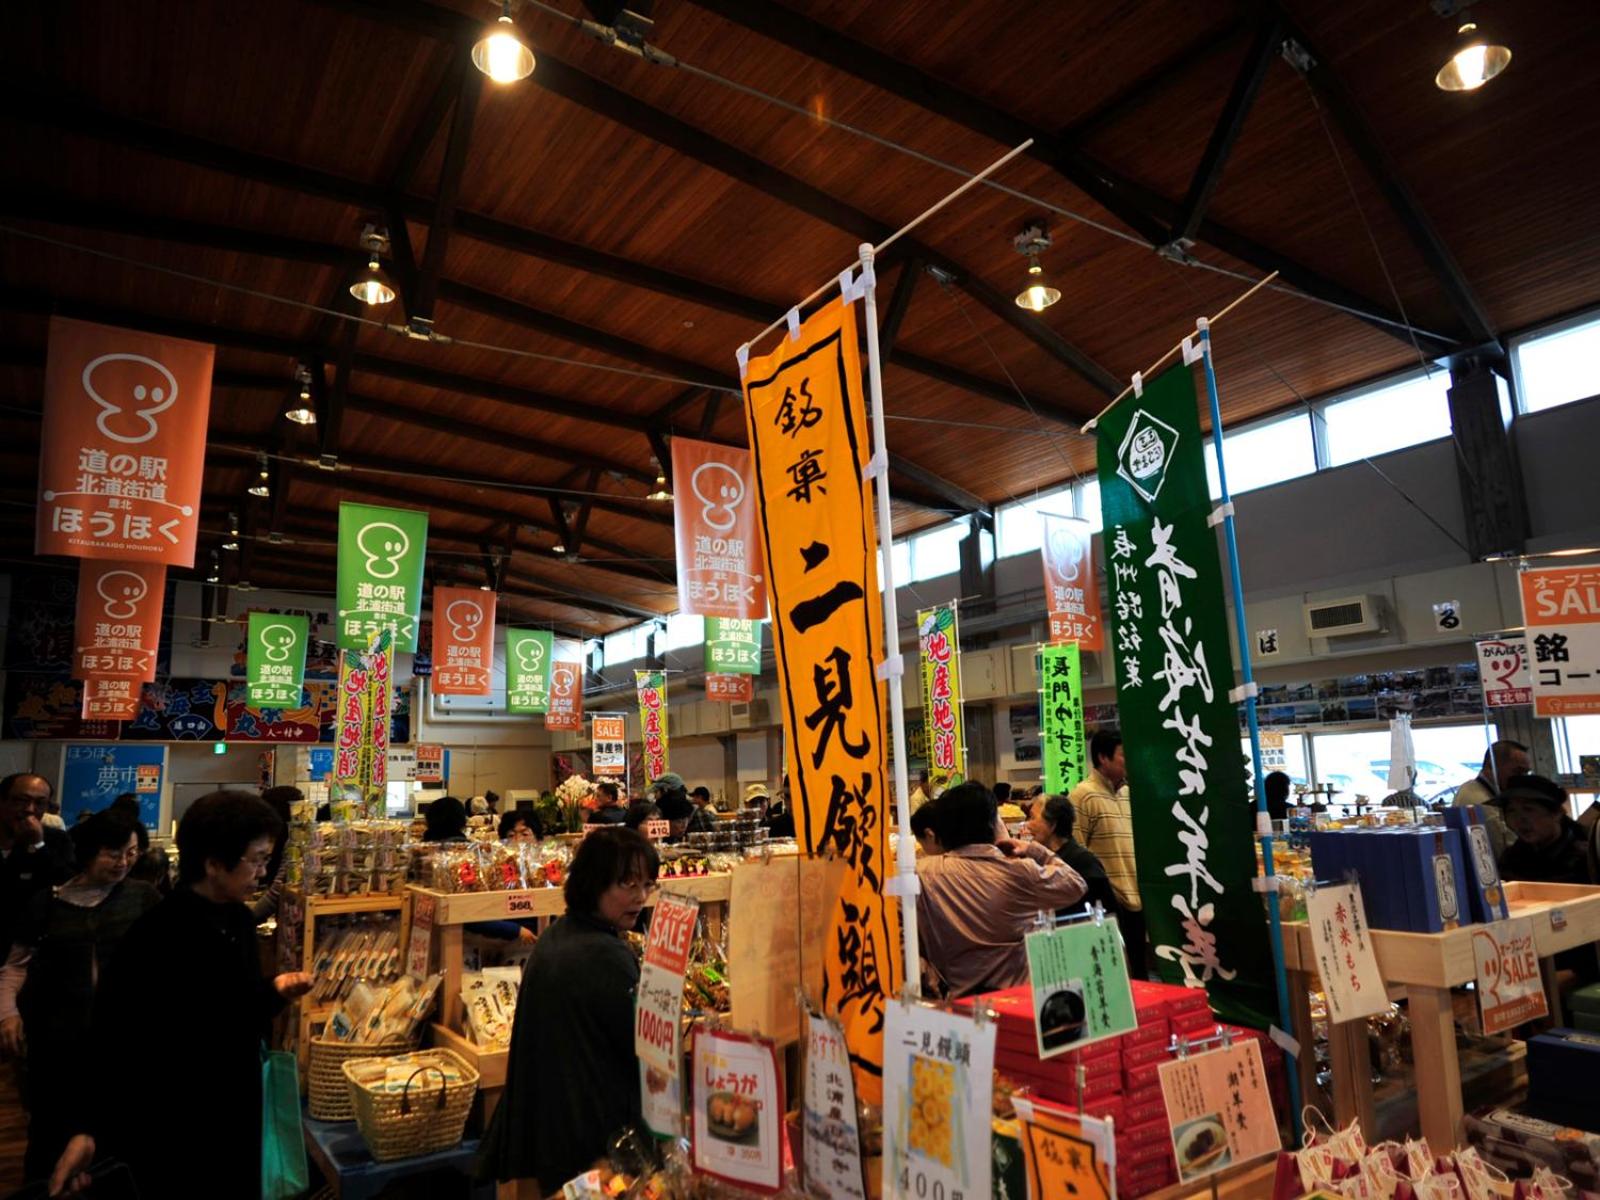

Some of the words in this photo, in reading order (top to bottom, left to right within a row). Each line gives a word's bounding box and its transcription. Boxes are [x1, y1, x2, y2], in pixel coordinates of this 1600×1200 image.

[78, 448, 168, 480] 道の駅
[76, 474, 167, 502] 北浦街道
[52, 506, 180, 545] ほうほく
[696, 535, 744, 557] 道の駅
[1534, 573, 1600, 590] オープニ
[357, 582, 405, 600] 道の駅
[686, 581, 755, 604] ほうほく
[1054, 585, 1084, 602] 道の駅
[356, 599, 405, 614] 北浦街道
[719, 617, 753, 630] 道の駅
[1440, 608, 1460, 629] る
[95, 623, 143, 638] 道の駅
[1051, 620, 1094, 638] ほうほく
[447, 645, 481, 658] 道の駅
[711, 648, 759, 663] ほうほく
[1534, 633, 1569, 663] 銘
[81, 654, 149, 671] ほうほく
[259, 664, 293, 676] 道の駅
[98, 681, 130, 690] 道の駅
[439, 672, 488, 687] ほうほく
[517, 674, 543, 684] 道の駅
[1539, 668, 1600, 686] コー
[251, 688, 299, 700] ほうほく
[709, 682, 746, 694] ほうほく
[511, 695, 548, 706] ほうほく
[928, 630, 955, 769] 地産地消
[1490, 691, 1532, 705] 東北物
[89, 702, 135, 713] ほうほく
[372, 651, 388, 786] 地産地消
[546, 715, 576, 725] ほうほく
[597, 725, 621, 737] SALE
[642, 688, 664, 780] 地産地消
[67, 746, 117, 761] ほうほく
[419, 749, 441, 758] SALE
[96, 764, 138, 796] 夢市
[651, 920, 688, 956] SALE
[1503, 952, 1538, 986] SALE
[638, 1006, 674, 1056] 1000円
[705, 1067, 758, 1096] しょうが
